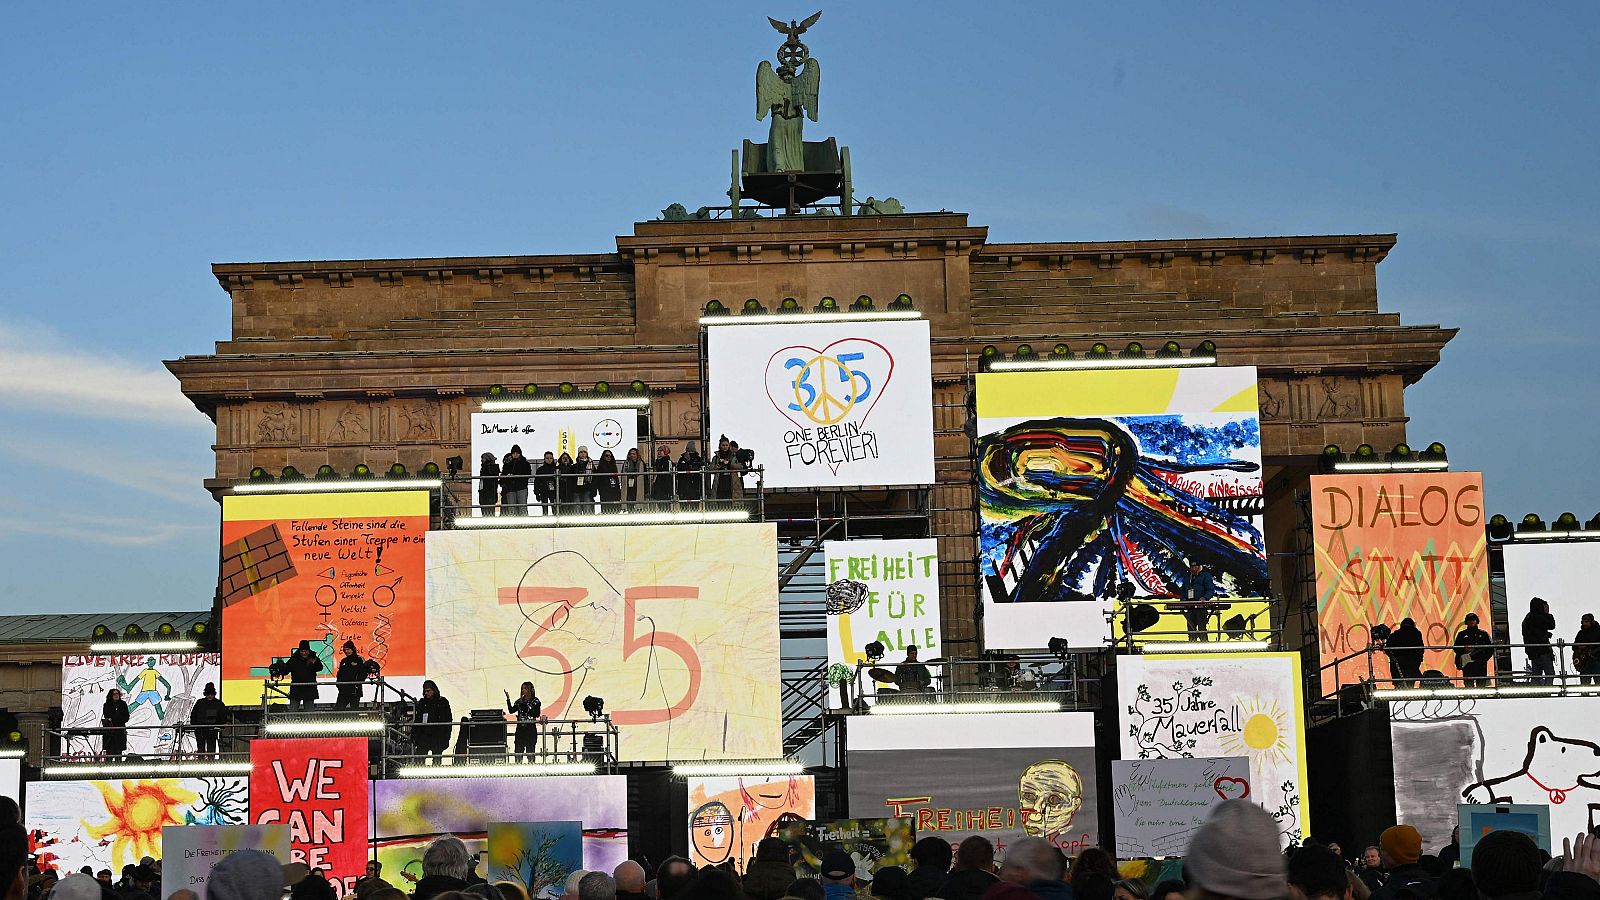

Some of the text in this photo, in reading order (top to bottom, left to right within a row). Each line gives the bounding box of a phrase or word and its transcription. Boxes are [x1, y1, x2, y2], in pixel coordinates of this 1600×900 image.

[784, 352, 871, 412] 35
[481, 424, 492, 434] Die
[784, 428, 813, 444] ONE
[786, 432, 879, 469] FOREVER!
[1321, 484, 1480, 530] DIALOG
[291, 518, 406, 531] Fallende Steine sind die
[292, 534, 331, 547] Stufen
[334, 537, 358, 546] einer
[361, 533, 399, 548] Treppe
[403, 535, 411, 543] in
[304, 552, 331, 560] neue
[1341, 555, 1474, 598] STATT
[341, 605, 367, 613] Vielfalt
[868, 591, 926, 619] FÜR
[341, 618, 368, 627] Toleranz
[875, 628, 936, 651] ALLE
[65, 655, 106, 667] LIVE
[497, 585, 702, 727] 35
[1151, 697, 1216, 714] 35 Jahre
[1151, 705, 1242, 743] Mauerfall
[272, 758, 343, 803] WE
[886, 796, 1037, 832] FREIHEIT
[1049, 834, 1090, 856] Kopf
[290, 847, 332, 870] BE
